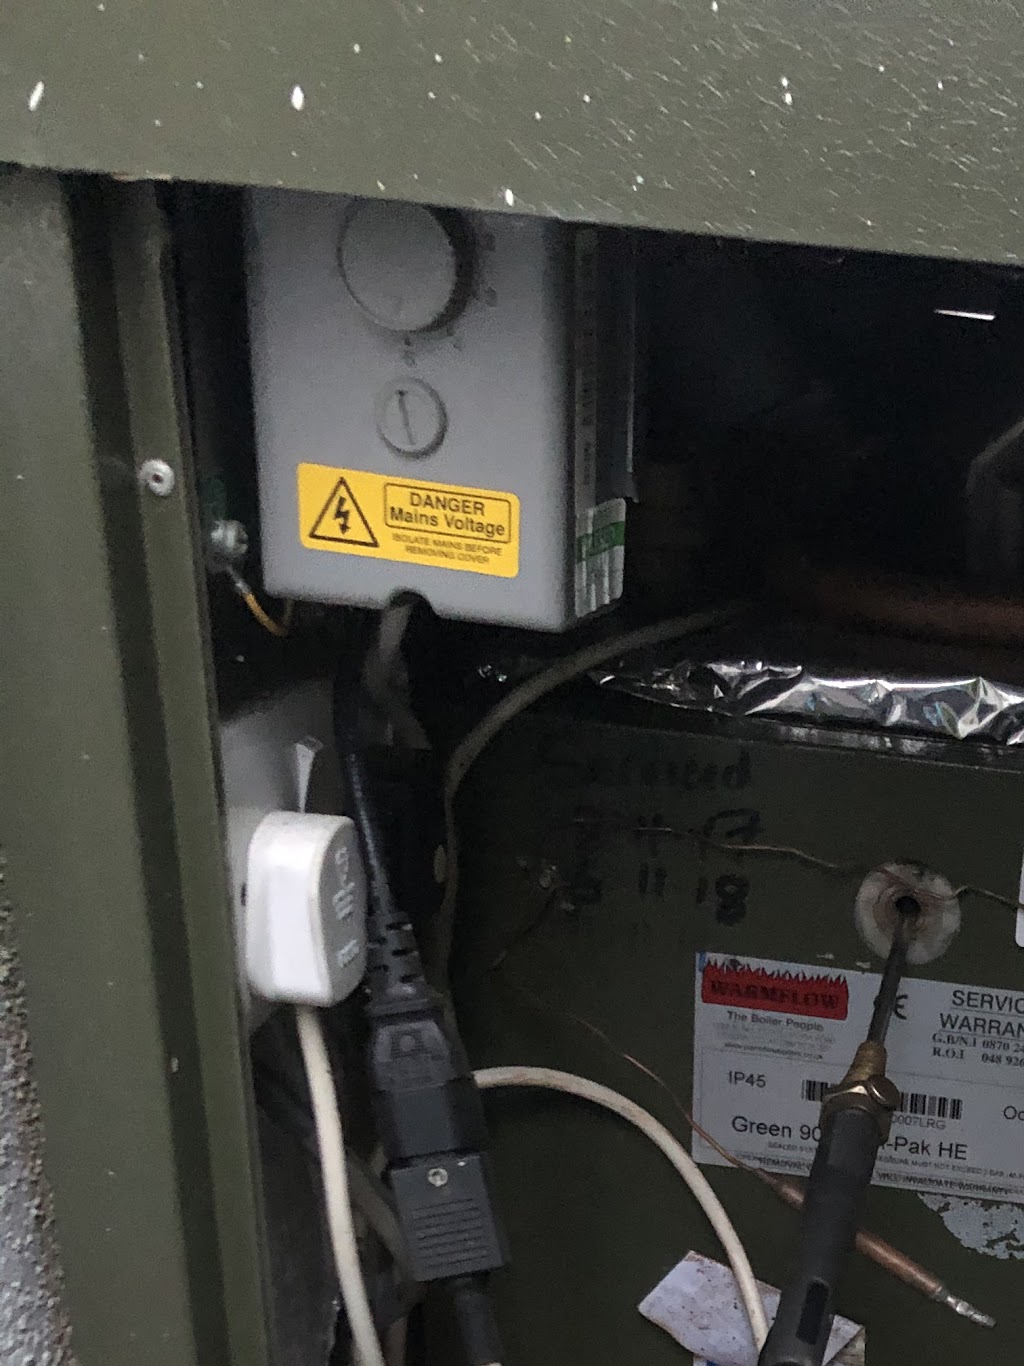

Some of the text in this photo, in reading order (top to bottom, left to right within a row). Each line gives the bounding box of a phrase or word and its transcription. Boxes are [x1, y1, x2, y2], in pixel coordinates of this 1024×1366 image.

[409, 491, 486, 516] DANGER
[390, 505, 506, 538] Mains Voltage
[465, 543, 503, 557] BEFORE
[727, 1010, 825, 1032] The Boiler People
[981, 1038, 1010, 1052] 0870
[981, 1052, 1003, 1065] 048
[728, 1070, 767, 1089] IP45
[731, 1115, 793, 1139] Green
[938, 1141, 969, 1161] HE
